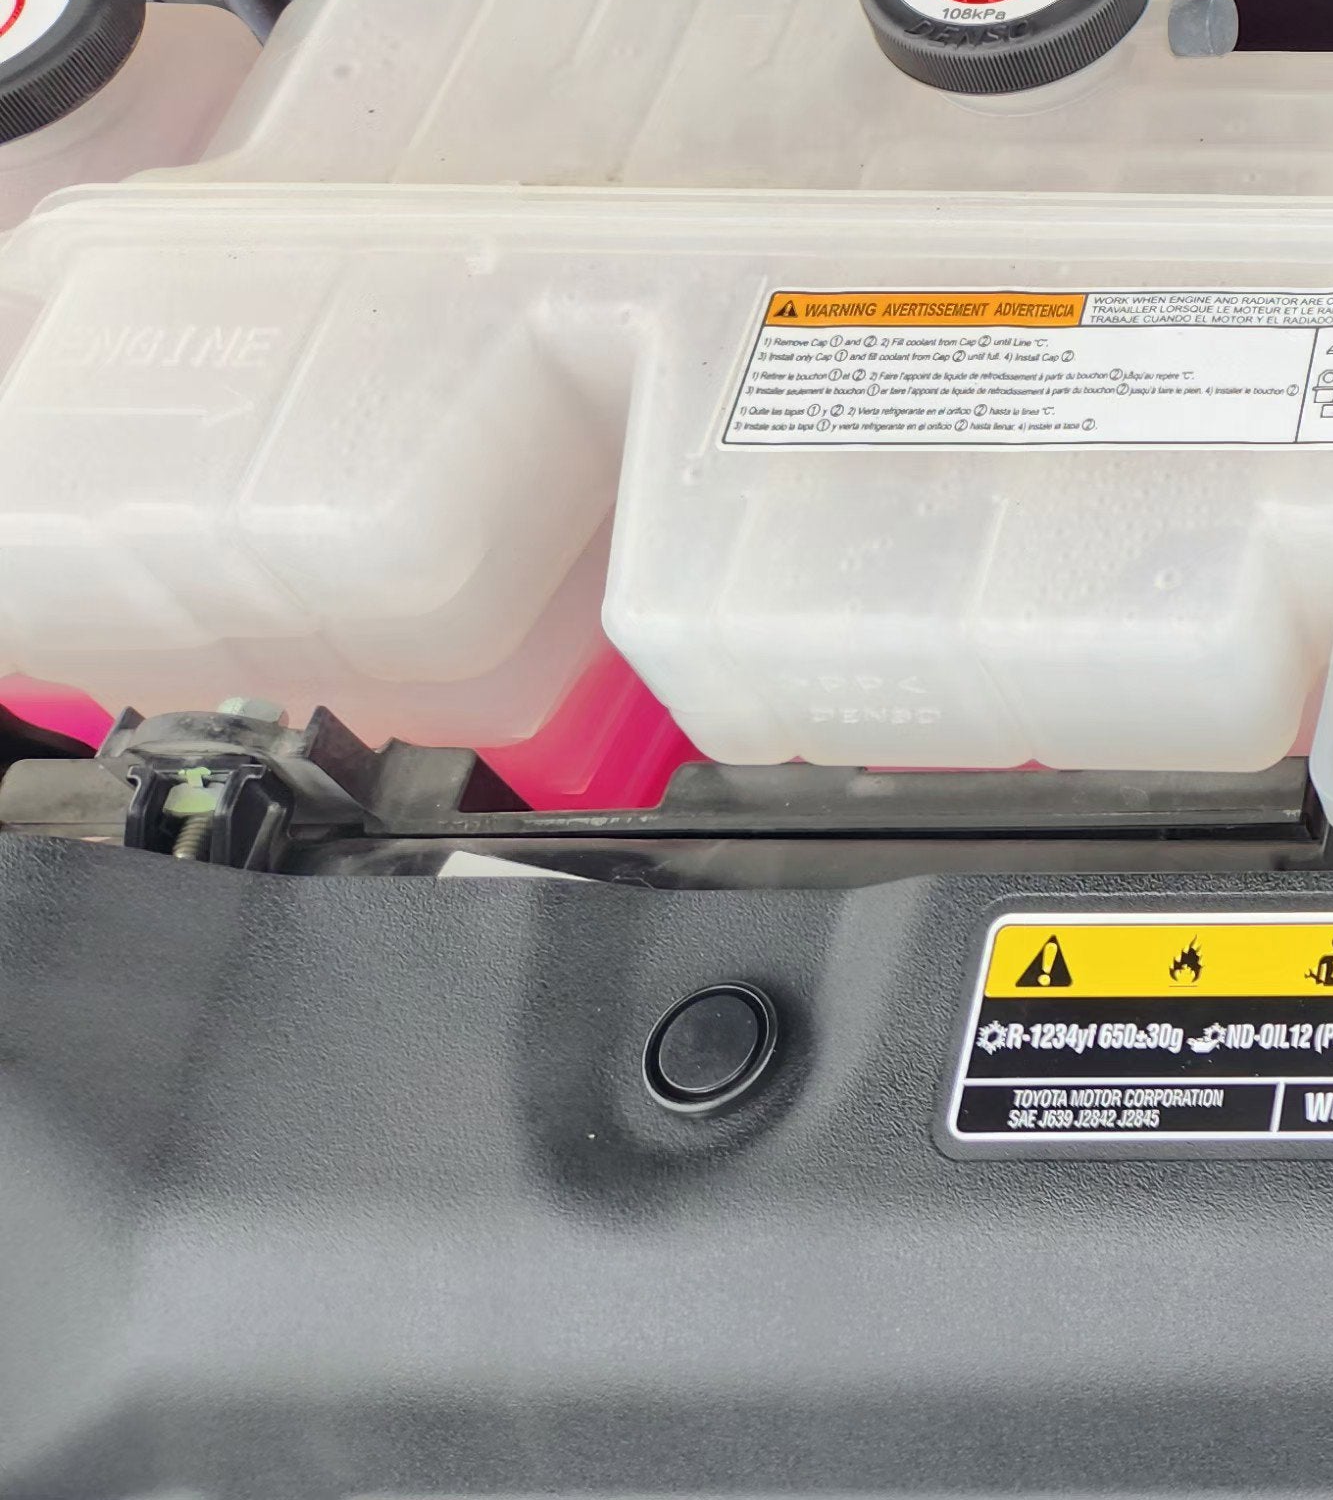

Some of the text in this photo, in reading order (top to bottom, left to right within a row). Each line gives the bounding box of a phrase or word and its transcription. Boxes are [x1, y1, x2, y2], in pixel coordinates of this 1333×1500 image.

[942, 7, 1006, 21] 108kPa
[1242, 297, 1298, 305] RADIATOR
[805, 303, 1074, 317] WARNING AVERTISSEMENT ADVERTENCIA
[1093, 305, 1157, 313] TRAVAILLER
[1160, 305, 1213, 313] LORSQUE
[1234, 306, 1281, 314] MOTEUR
[1090, 315, 1141, 323] TRABAJE
[1143, 315, 1191, 323] CUANDO
[1195, 315, 1206, 323] EL
[1212, 315, 1253, 323] MOTOR
[1267, 316, 1278, 324] EL
[48, 325, 282, 369] ENGINE
[1006, 1023, 1098, 1054] R-1234yf
[1225, 1023, 1313, 1050] ND-OIL12
[1013, 1089, 1225, 1108] TOYOTA MOTOR CORPORATION
[1007, 1109, 1161, 1129] SAE J639 J2842 J2845
